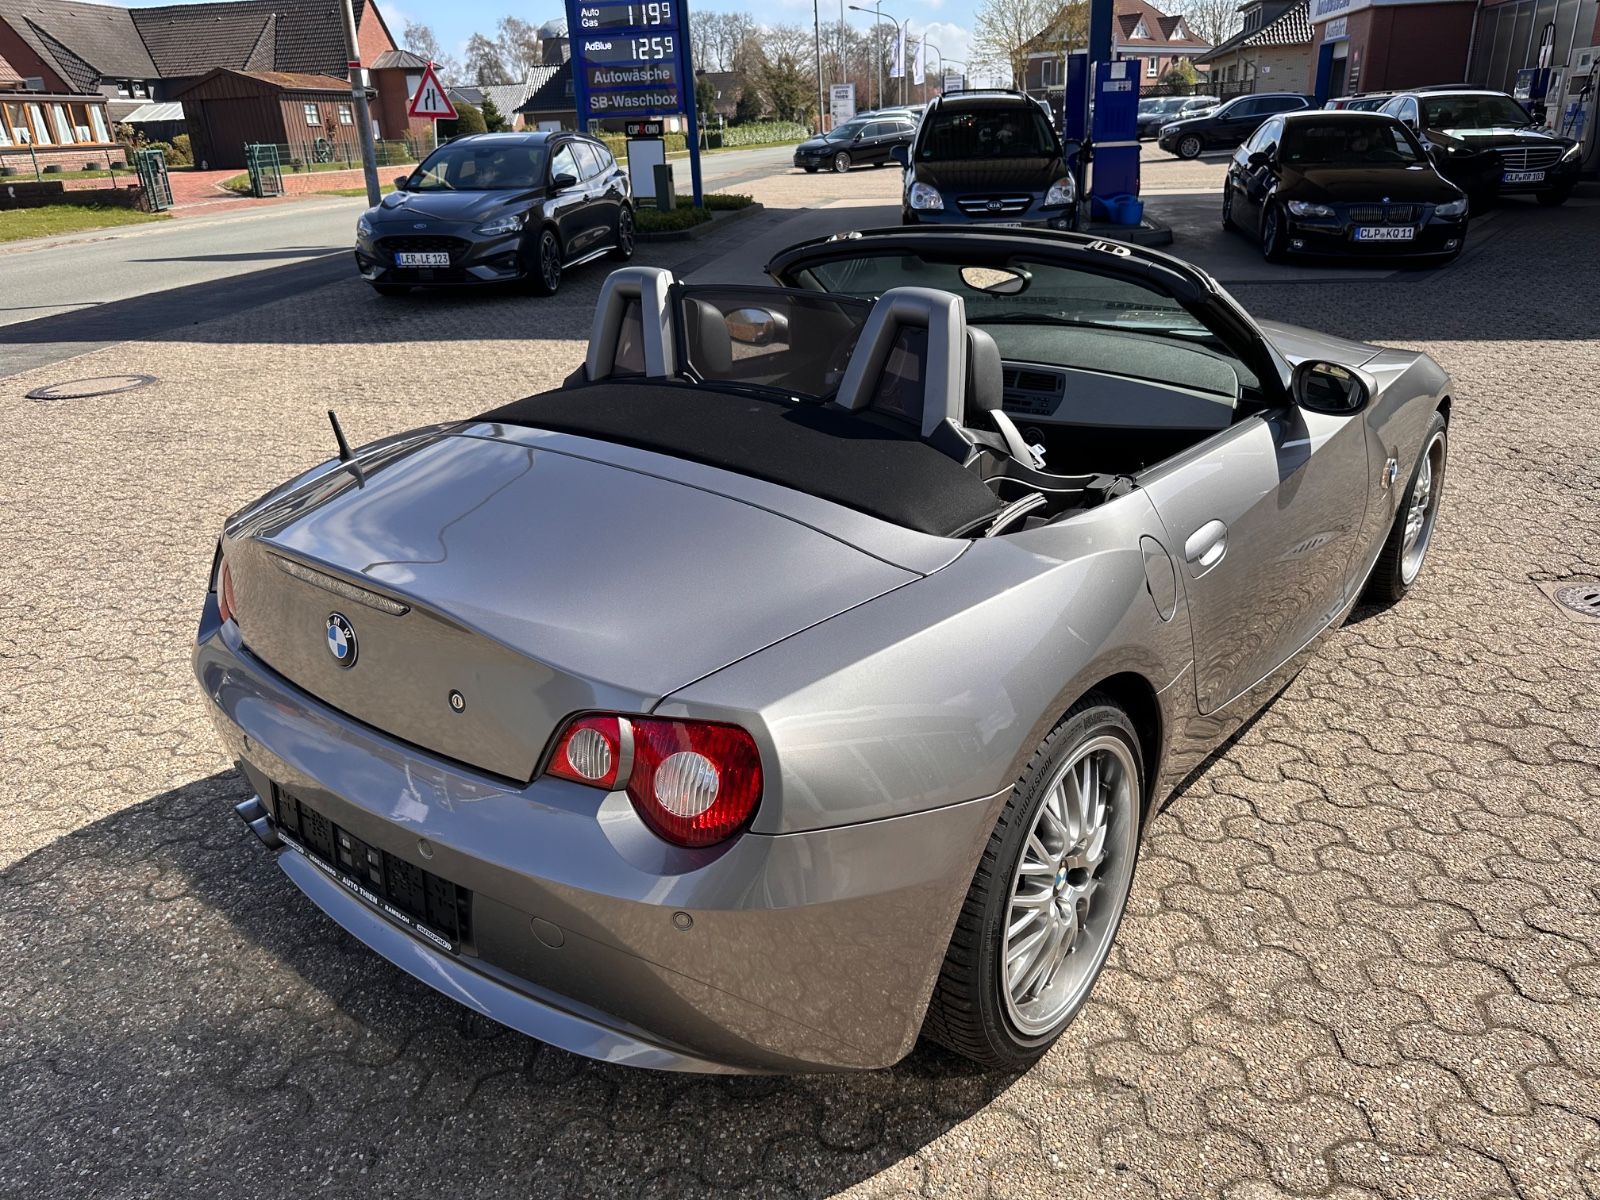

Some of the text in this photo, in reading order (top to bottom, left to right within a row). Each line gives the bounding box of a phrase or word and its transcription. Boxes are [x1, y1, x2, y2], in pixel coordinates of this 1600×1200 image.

[581, 8, 599, 17] Auto
[581, 18, 598, 28] Gas
[584, 41, 612, 51] AdBlue
[593, 68, 670, 84] Autowäsche
[590, 93, 678, 109] SB-Waschbox
[1360, 228, 1380, 239] CLP
[401, 254, 416, 264] LER
[326, 617, 352, 638] BMW
[342, 876, 359, 892] AUTO
[359, 887, 378, 905] THIEN
